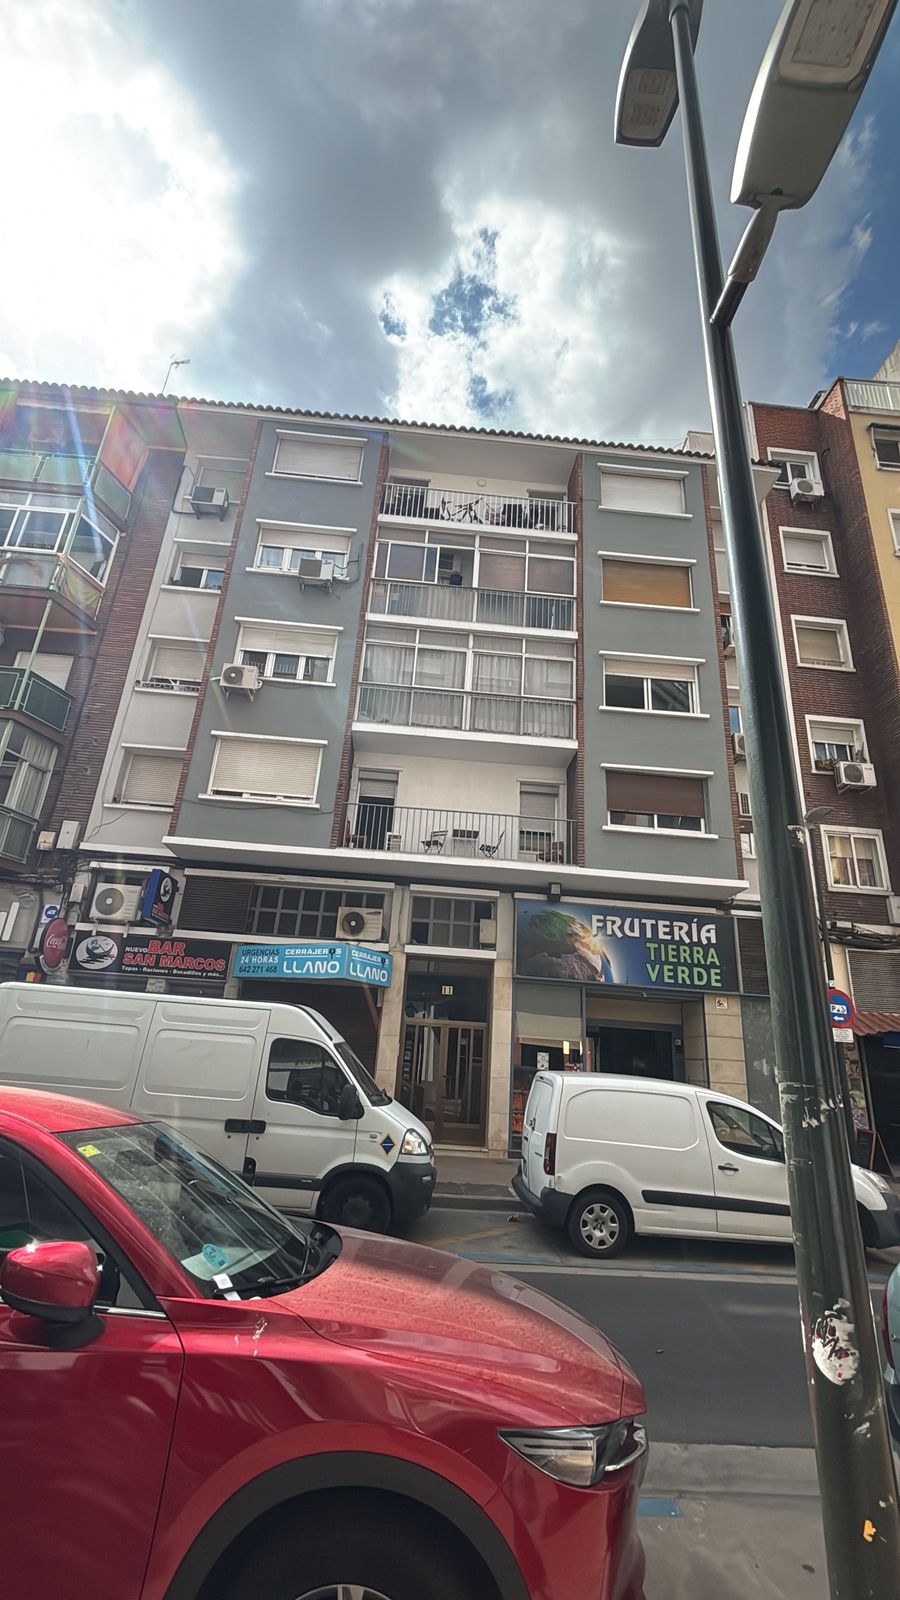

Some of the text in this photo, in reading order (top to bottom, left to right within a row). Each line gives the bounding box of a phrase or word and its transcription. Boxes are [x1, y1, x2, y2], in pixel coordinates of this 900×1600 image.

[591, 914, 717, 945] FRUTERÍA
[147, 939, 186, 956] BAR
[241, 948, 280, 956] URGENCIAS
[645, 942, 720, 966] TIERRA
[122, 952, 226, 971] SAN MARCOS
[240, 956, 279, 964] 24 HORAS
[282, 960, 341, 974] LLANO
[143, 966, 169, 974] Raciones
[238, 965, 251, 973] 642
[252, 965, 264, 973] 271
[349, 962, 389, 982] LLANO
[646, 963, 722, 987] VERDE
